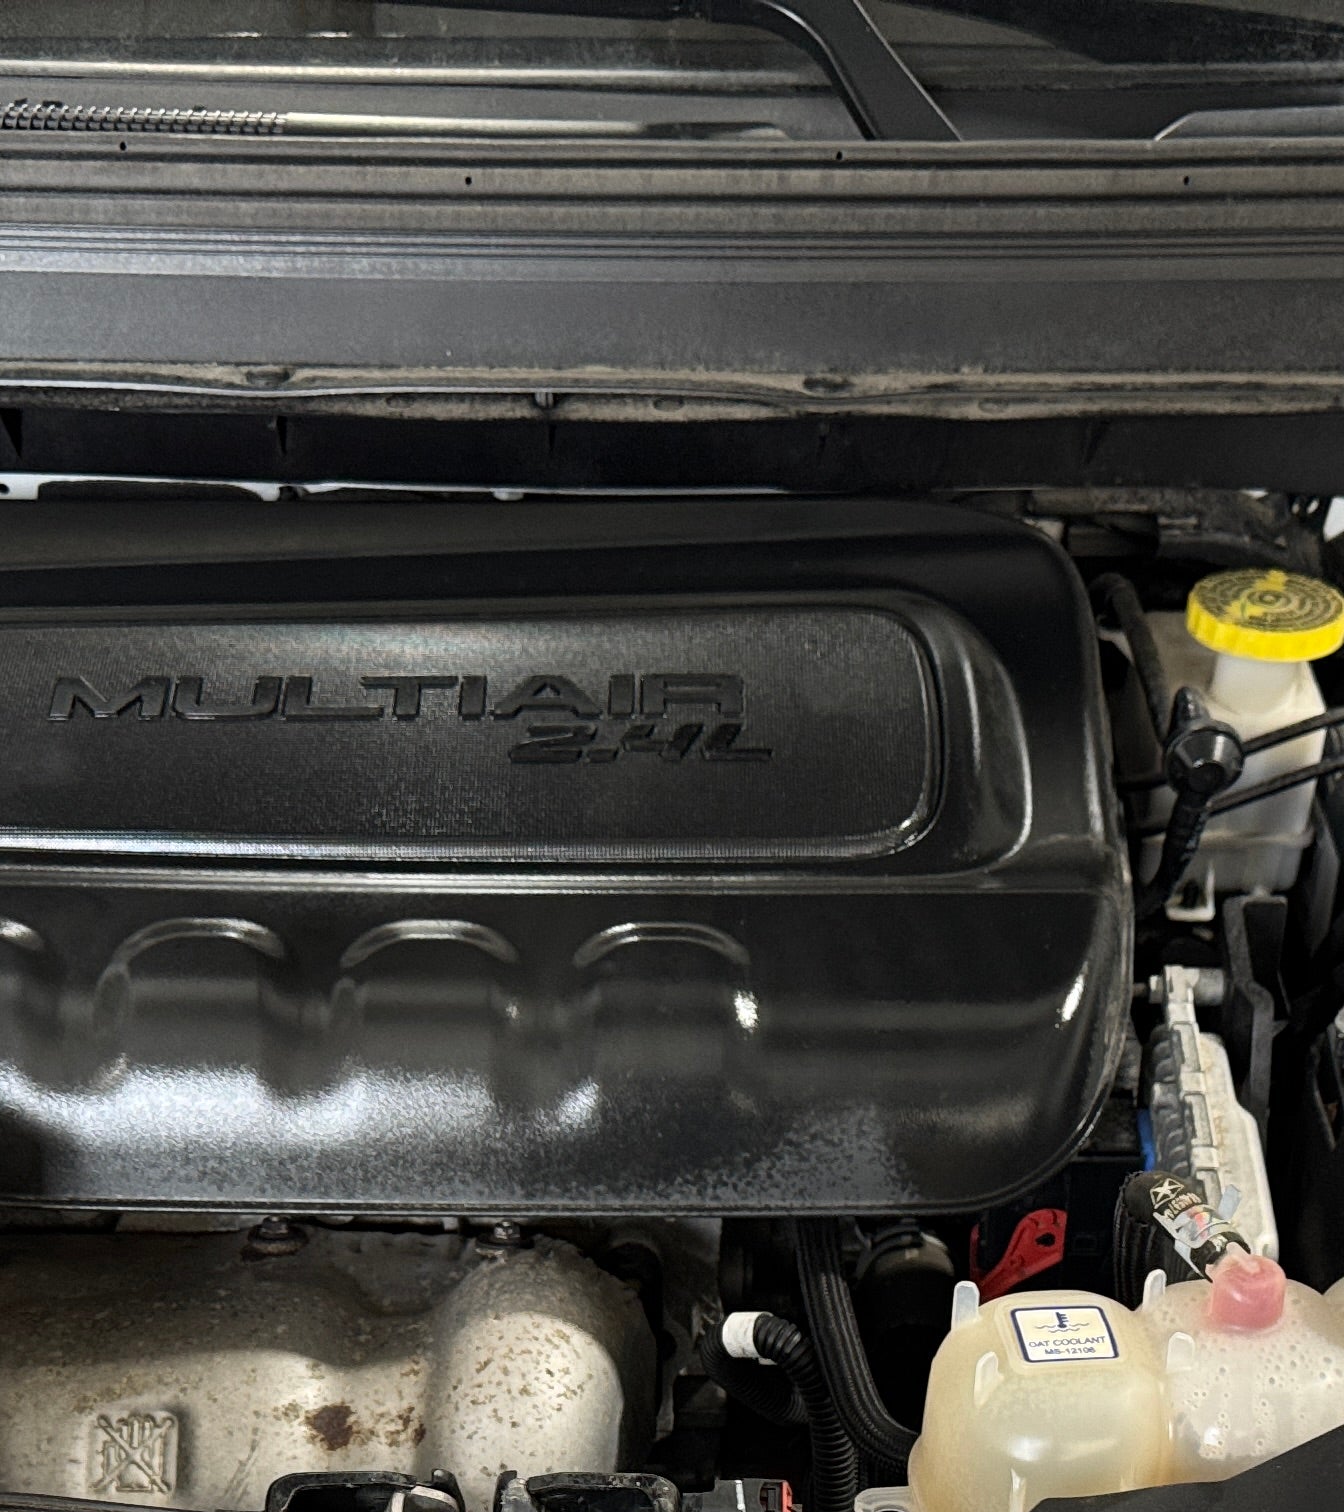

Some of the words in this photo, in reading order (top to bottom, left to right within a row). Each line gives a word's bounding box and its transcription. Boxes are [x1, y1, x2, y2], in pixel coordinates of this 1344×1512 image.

[48, 674, 743, 721] MULTIAIR
[508, 721, 773, 764] 2.4L
[1028, 1340, 1050, 1348] OAT
[1052, 1336, 1106, 1347] COOLANT
